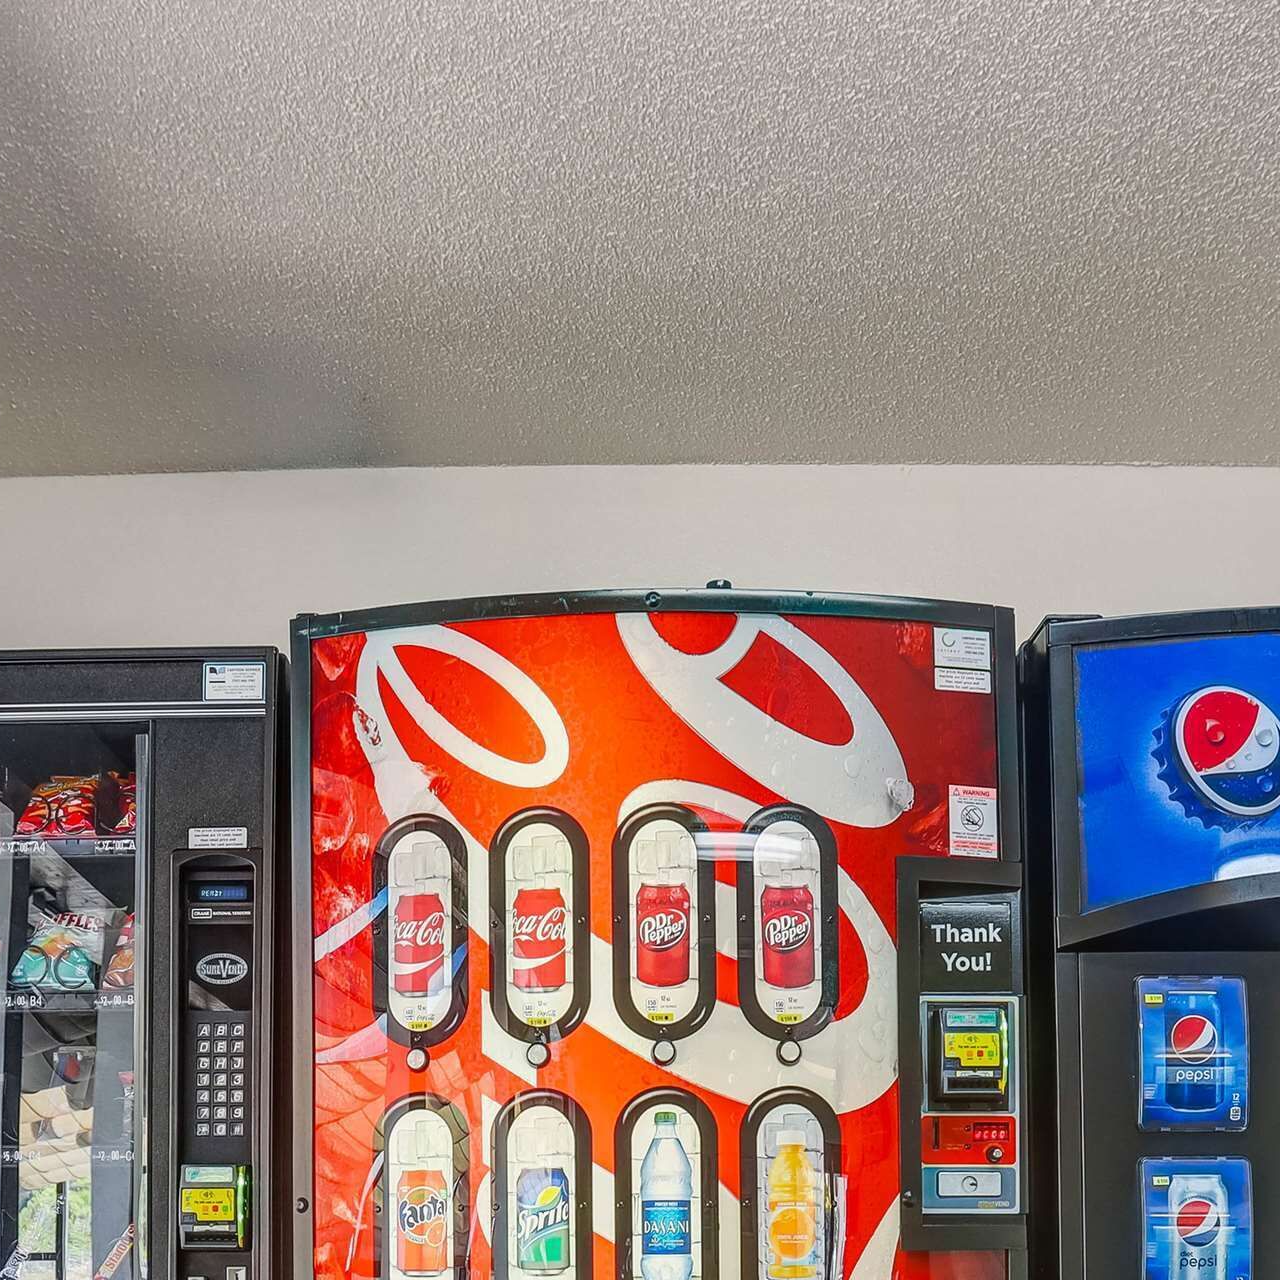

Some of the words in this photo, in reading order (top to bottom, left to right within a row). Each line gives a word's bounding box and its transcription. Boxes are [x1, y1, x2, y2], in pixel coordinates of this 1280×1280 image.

[962, 789, 990, 797] WARNING
[33, 842, 46, 852] A4
[51, 911, 101, 932] UFFLES
[656, 913, 675, 928] Dr
[781, 914, 799, 929] Dr
[642, 915, 684, 945] Pepper
[768, 916, 809, 946] Pepper
[930, 923, 1002, 943] Thank
[941, 952, 992, 972] You!
[29, 996, 42, 1006] B4
[200, 1025, 209, 1036] A
[217, 1025, 225, 1036] B
[233, 1025, 241, 1036] C
[200, 1041, 209, 1051] D
[217, 1041, 225, 1051] E
[233, 1041, 241, 1051] F
[200, 1058, 209, 1068] G
[217, 1058, 225, 1068] H
[233, 1058, 241, 1068] J
[200, 1075, 209, 1085] 1
[217, 1075, 225, 1085] 2
[233, 1075, 241, 1085] 3
[1176, 1069, 1214, 1083] pepsi
[200, 1092, 209, 1102] 4
[217, 1092, 225, 1102] 5
[233, 1092, 241, 1102] 6
[200, 1108, 209, 1118] 7
[217, 1108, 225, 1118] 8
[233, 1108, 241, 1118] 9
[518, 1200, 569, 1239] Sprite
[644, 1218, 689, 1234] DASANI
[1180, 1254, 1217, 1270] pepsi
